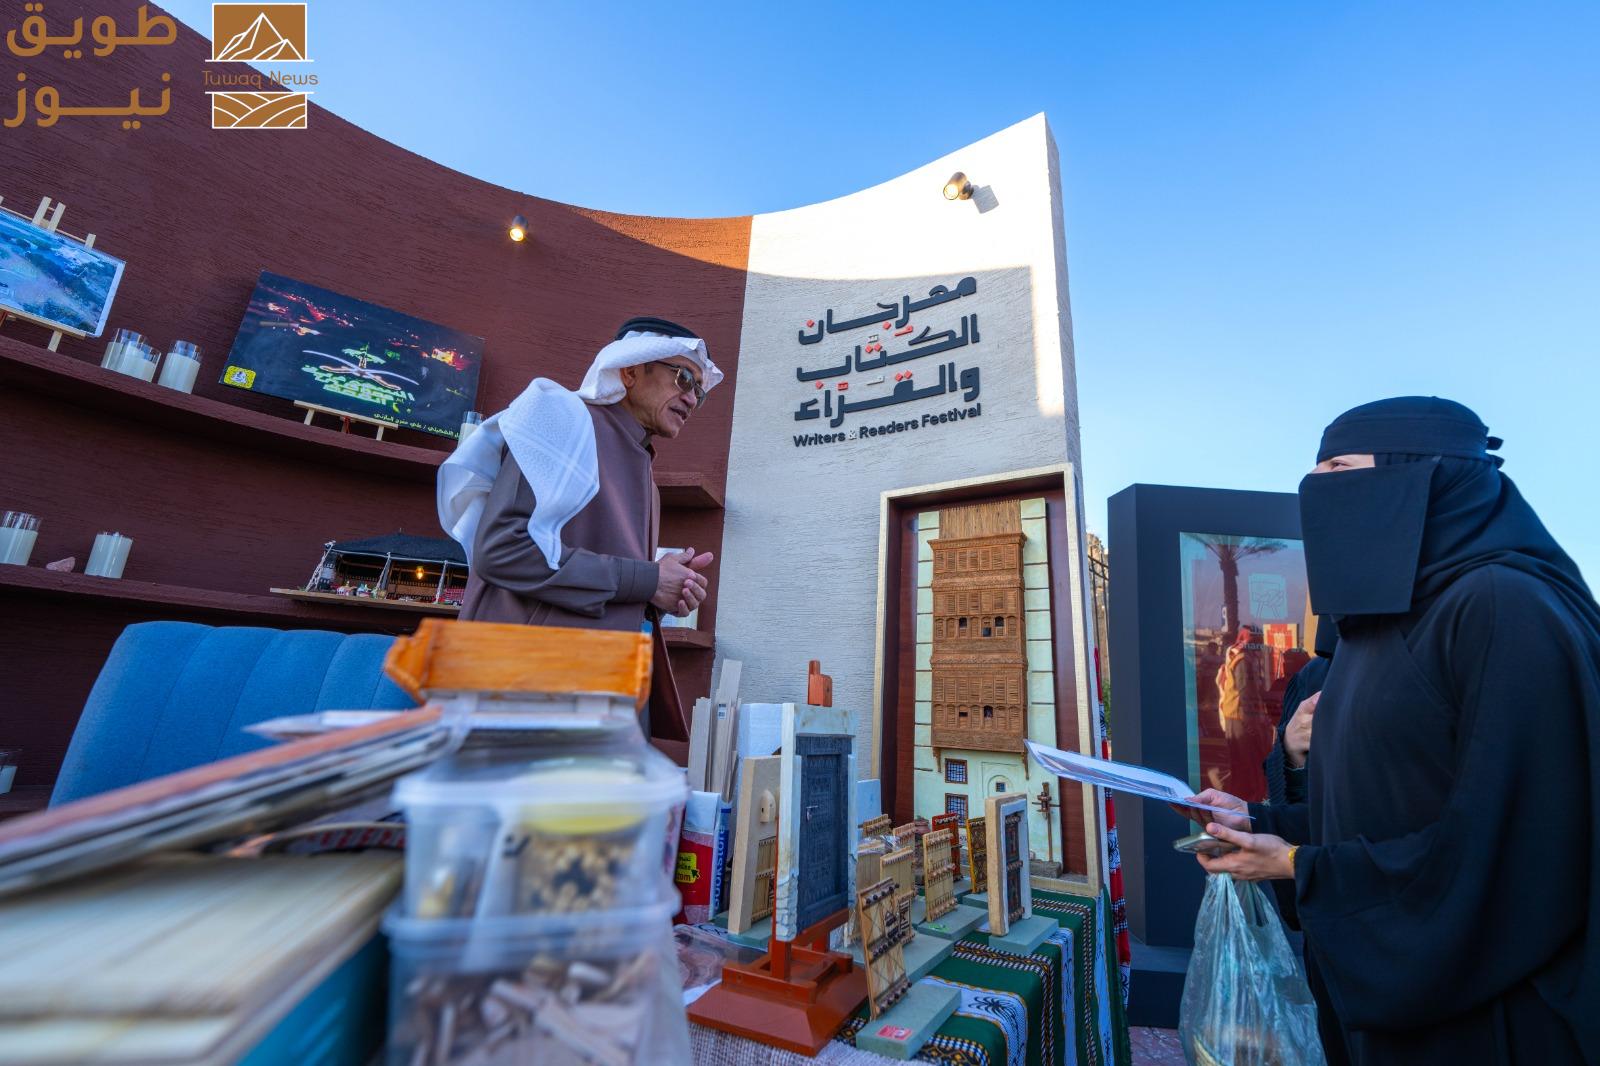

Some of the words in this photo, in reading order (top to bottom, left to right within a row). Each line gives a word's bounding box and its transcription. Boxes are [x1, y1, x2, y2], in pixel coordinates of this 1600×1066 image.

[799, 276, 977, 345] مهرجان
[793, 431, 846, 448] Writers
[848, 430, 857, 440] &
[859, 420, 919, 439] Readers
[921, 403, 981, 428] Festival
